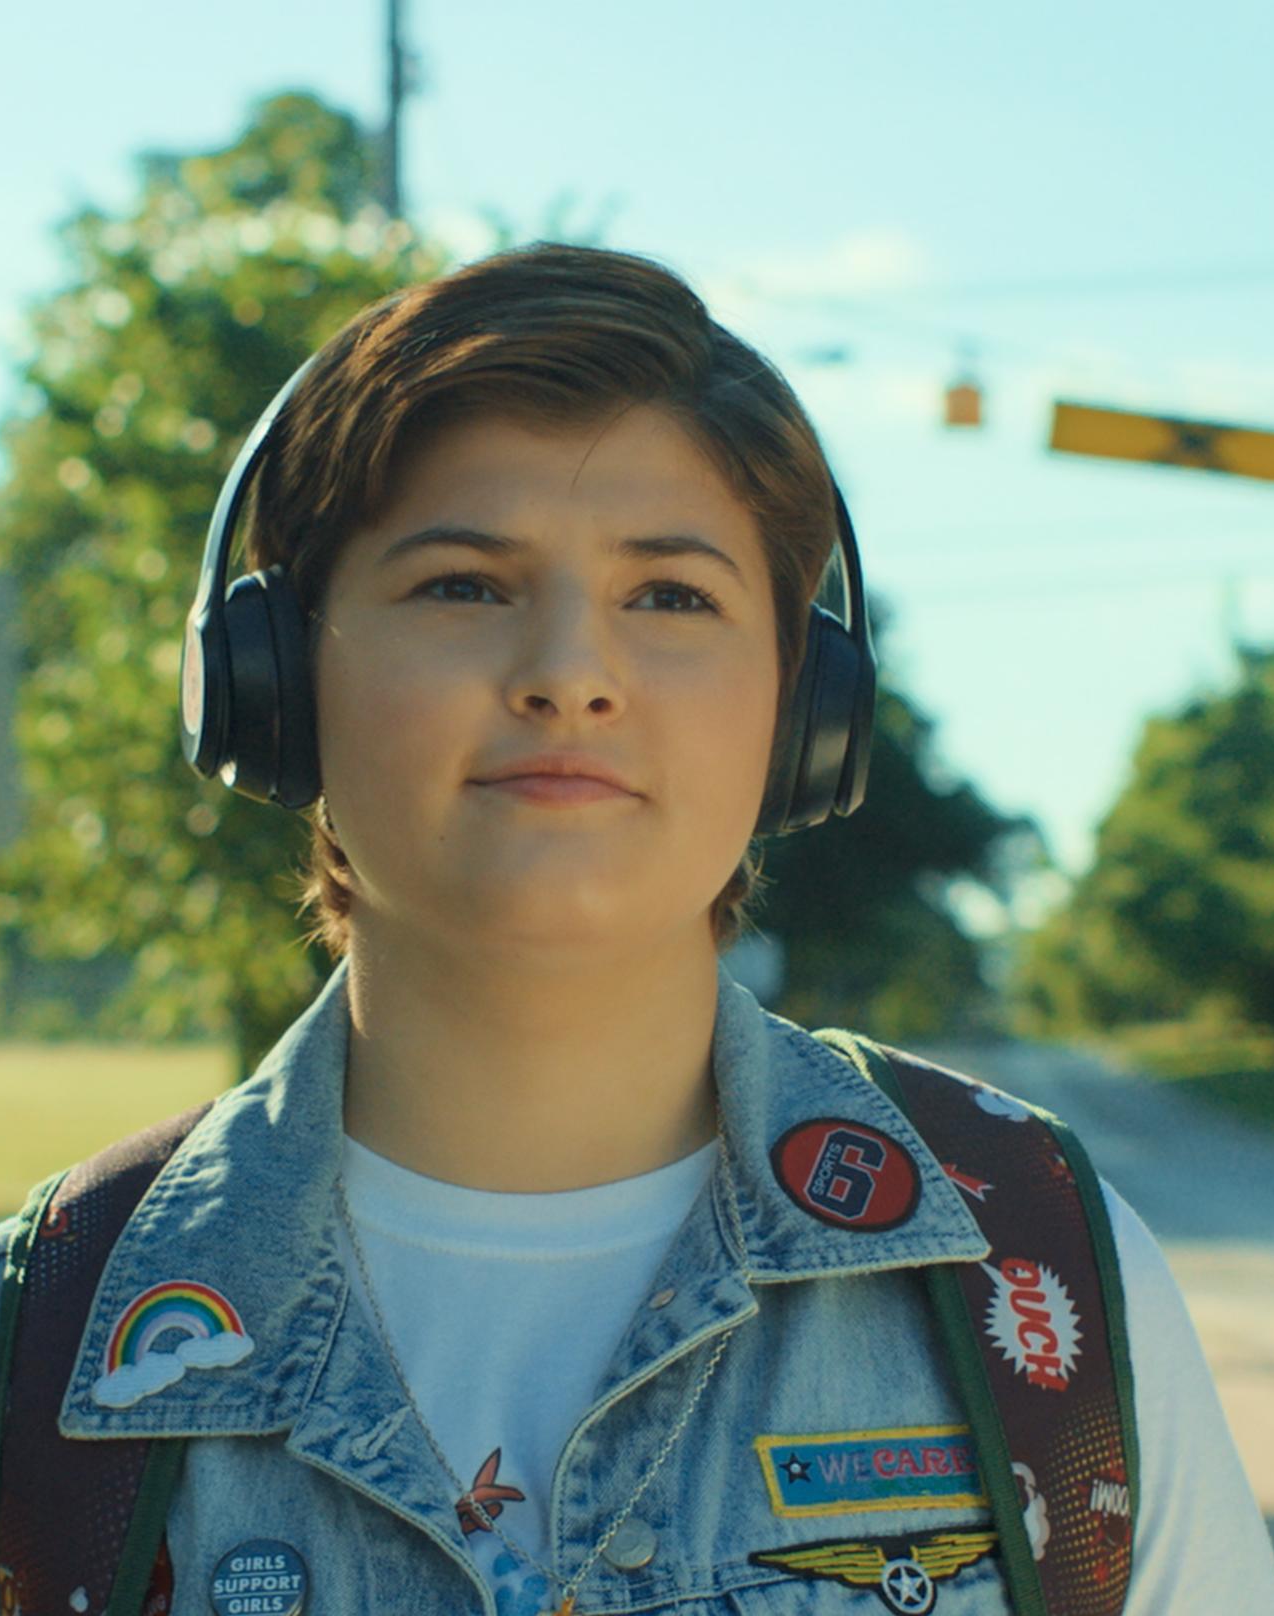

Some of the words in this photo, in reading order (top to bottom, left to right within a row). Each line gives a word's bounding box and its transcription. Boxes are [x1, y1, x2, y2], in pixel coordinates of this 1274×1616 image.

[803, 1127, 887, 1221] 6
[812, 1142, 843, 1196] SPORTS
[1000, 1257, 1069, 1392] OUCH
[816, 1450, 871, 1485] WE
[872, 1446, 978, 1479] CARE
[230, 1555, 286, 1572] GIRLS
[213, 1574, 302, 1594] SUPPORT
[228, 1596, 284, 1614] GIRLS
